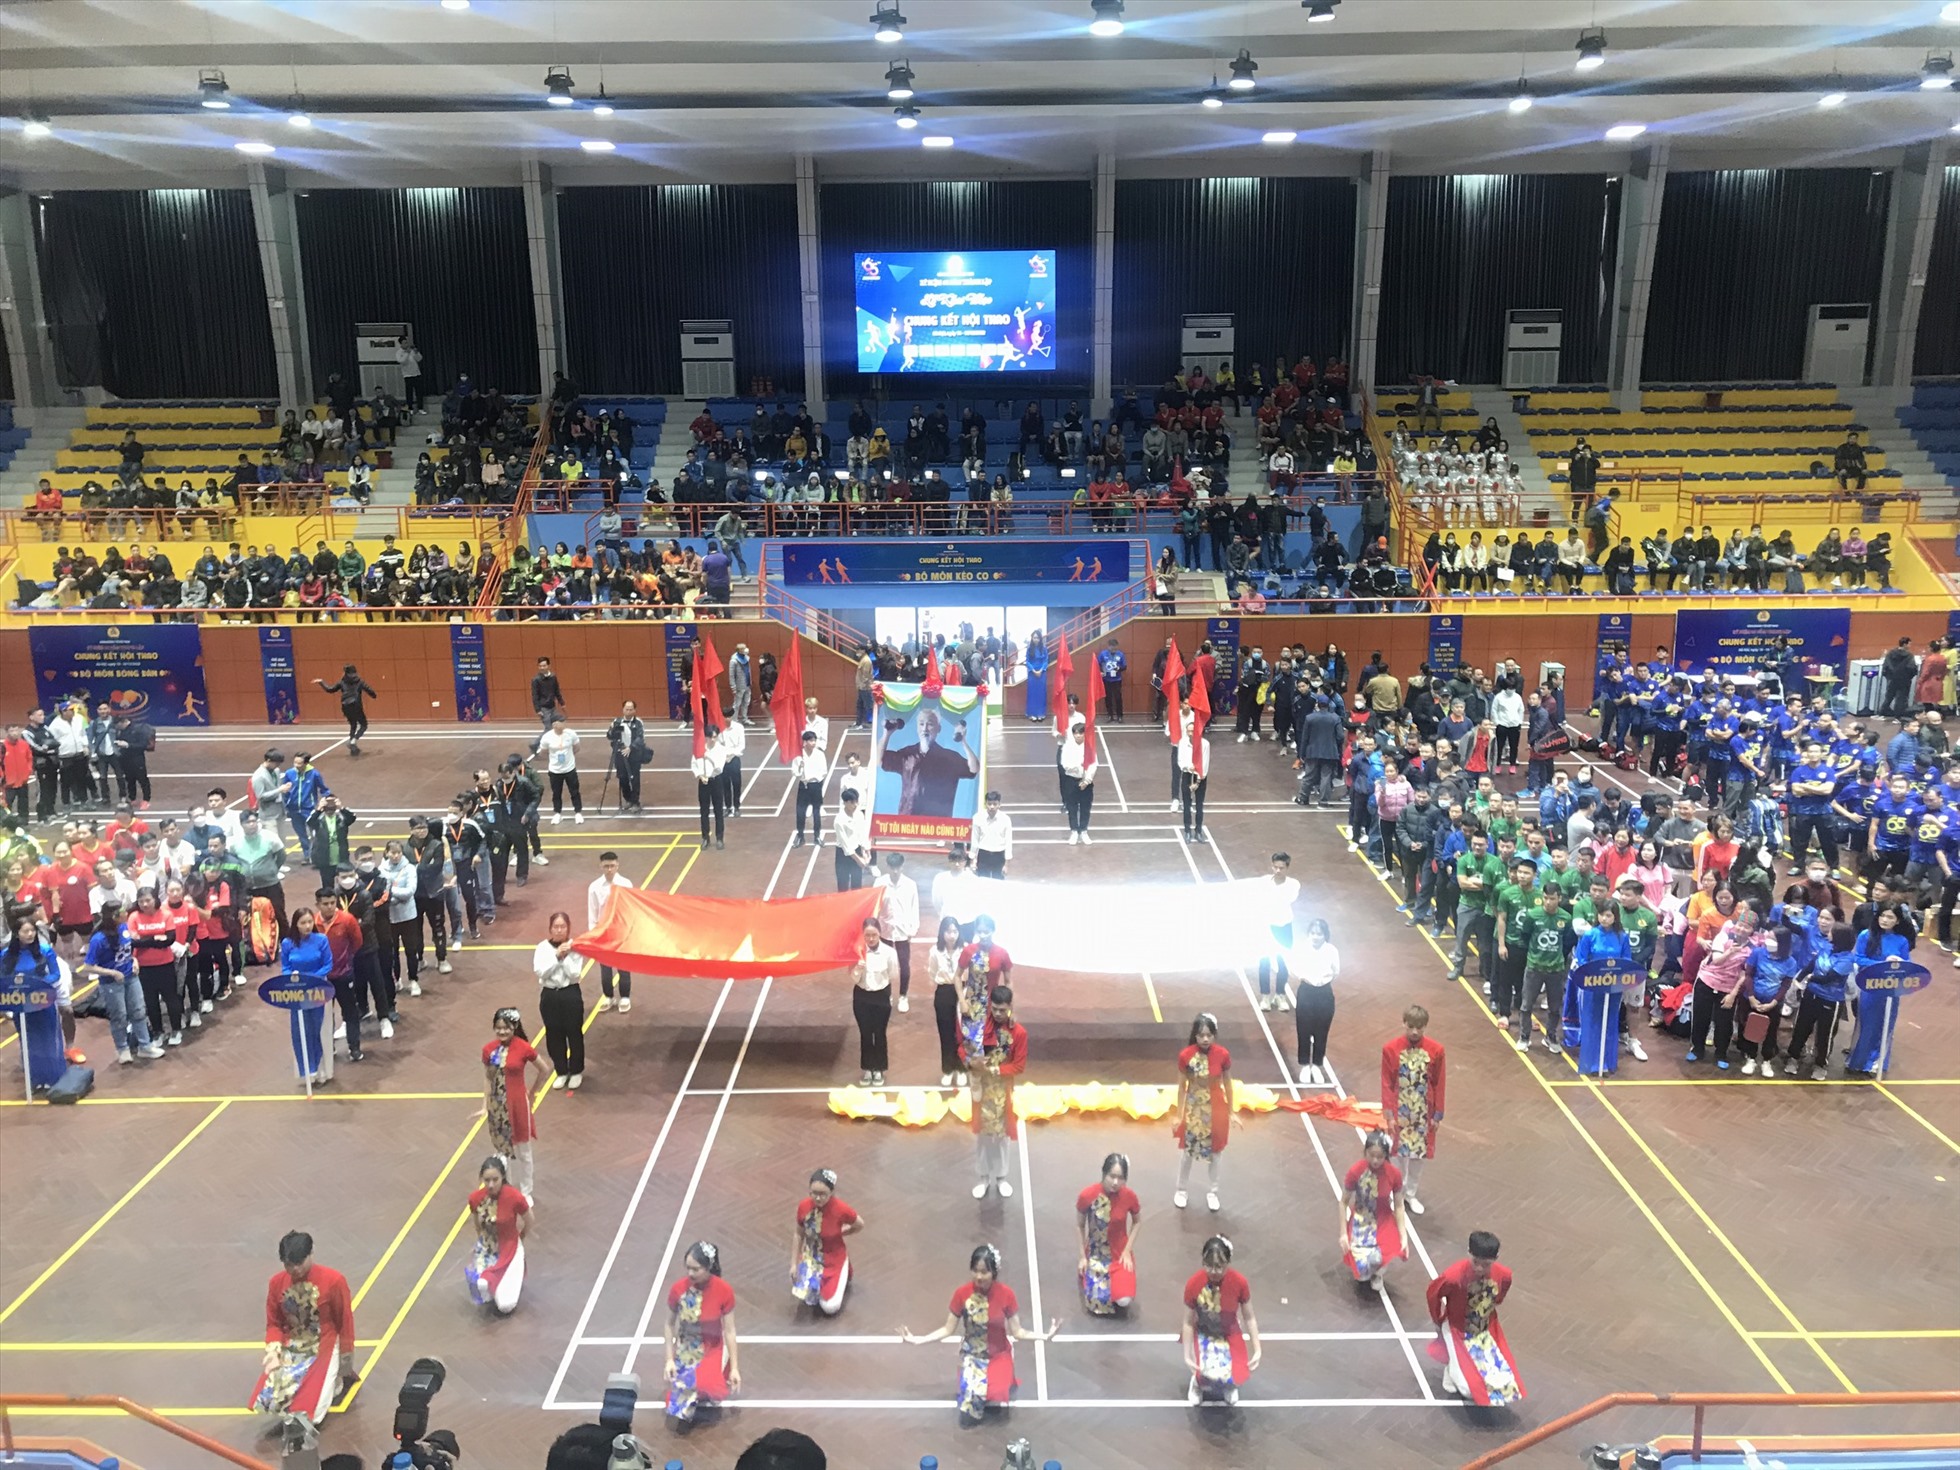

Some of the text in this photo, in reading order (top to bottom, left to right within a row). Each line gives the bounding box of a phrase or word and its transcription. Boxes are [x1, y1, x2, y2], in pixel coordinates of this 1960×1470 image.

[976, 572, 989, 580] CO
[1584, 971, 1617, 987] KHỐI
[1865, 974, 1920, 990] KHỐI 03
[0, 989, 49, 1005] HỐI 02
[268, 989, 304, 1004] TRỌNG
